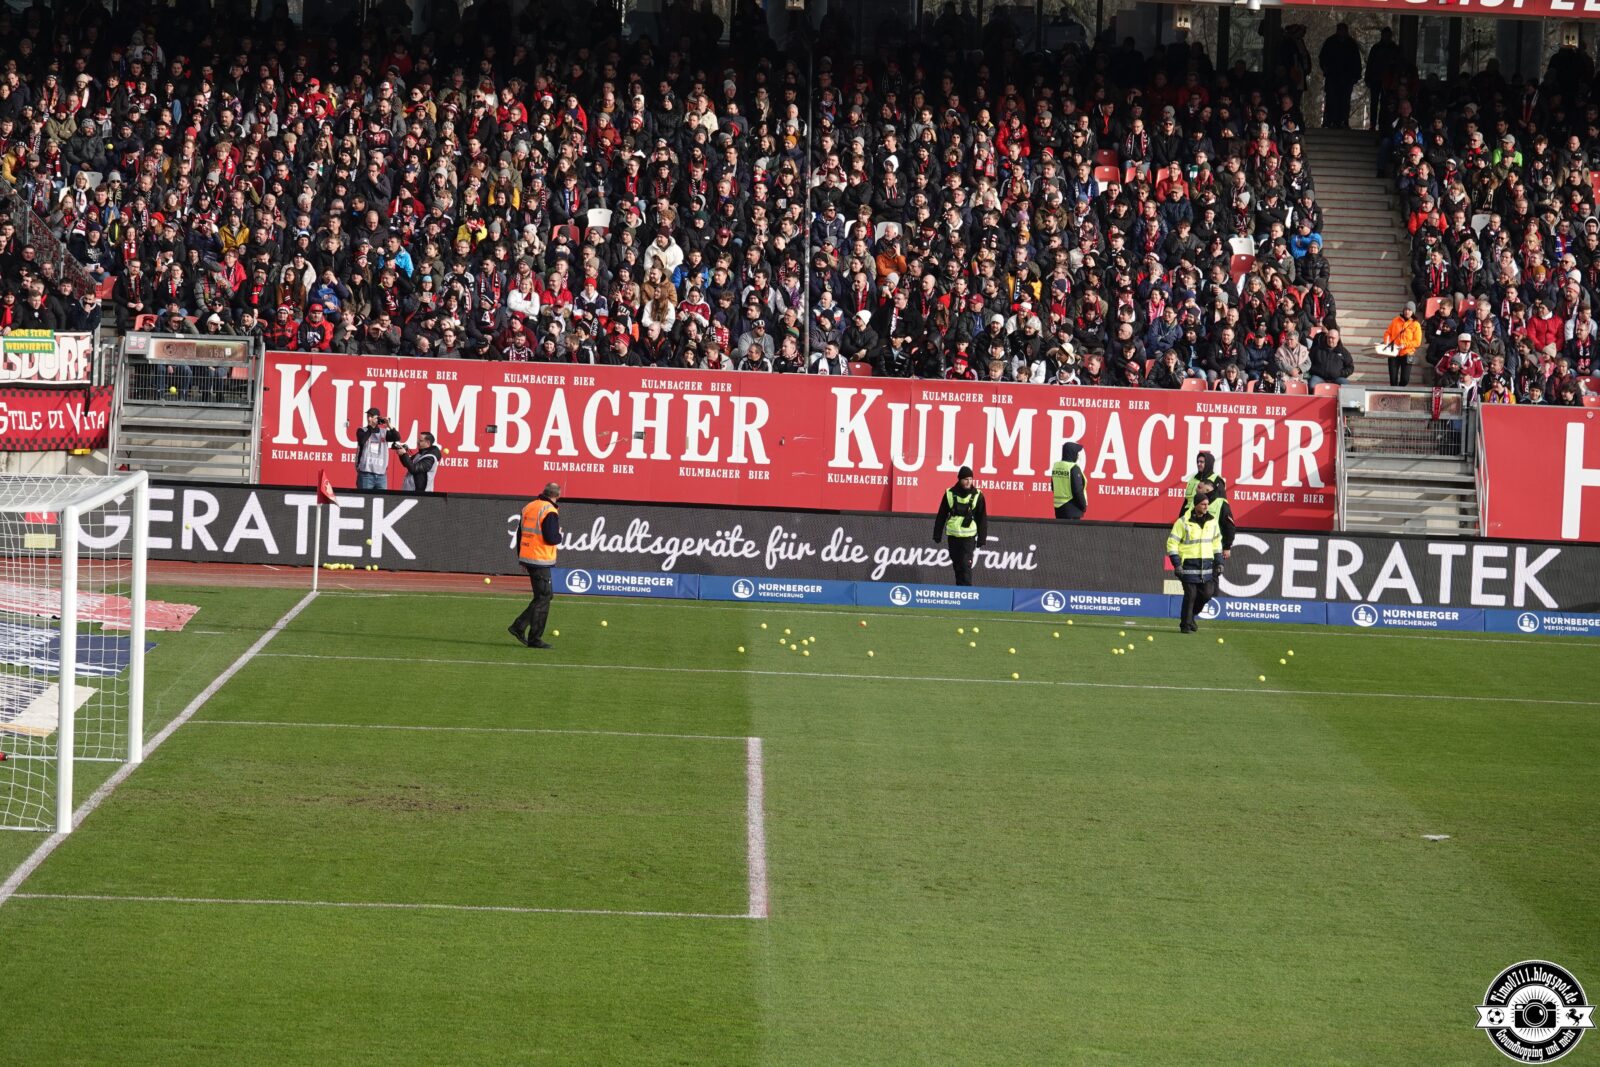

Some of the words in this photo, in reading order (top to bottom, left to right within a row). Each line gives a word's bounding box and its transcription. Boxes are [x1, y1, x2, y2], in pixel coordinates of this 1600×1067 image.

[366, 367, 428, 380] KULMBACHER
[436, 370, 458, 381] BIER
[504, 373, 566, 385] KULMBACHER
[573, 375, 595, 386] BIER
[641, 378, 703, 391] KULMBACHER
[710, 382, 732, 392] BIER
[922, 390, 984, 403] KULMBACHER
[992, 393, 1013, 404] BIER
[1059, 396, 1121, 409] KULMBACHER
[1128, 400, 1150, 410] BIER
[272, 363, 771, 465] KULMBACHER
[1196, 402, 1258, 415] KULMBACHER
[1265, 406, 1287, 416] BIER
[827, 387, 1325, 488] KULMBACHER
[271, 449, 334, 462] KULMBACHER
[341, 452, 357, 463] BIE
[477, 458, 499, 469] BIER
[543, 460, 605, 473] KULMBACHER
[612, 464, 634, 475] BIER
[679, 466, 740, 479] KULMBACHER
[748, 469, 770, 480] BIER
[827, 473, 889, 485] KULMBACHER
[896, 476, 918, 487] BIER
[1098, 484, 1159, 497] KULMBACHER
[1234, 490, 1295, 503] KULMBACHER
[1303, 493, 1325, 504] BIER
[77, 488, 419, 560] GERATEK
[765, 525, 815, 570] für
[821, 526, 868, 562] die
[870, 547, 953, 581] ganze
[1218, 533, 1561, 609] GERATEK
[597, 574, 674, 587] NÜRNBERGER
[597, 584, 651, 593] VERSICHERUNG
[758, 583, 822, 593] NÜRNBERGER
[758, 591, 804, 599] VERSICHERUNG
[915, 589, 979, 600] NÜRNBERGER
[1070, 594, 1141, 606] NÜRNBERGER
[1225, 601, 1301, 613] NÜRNBERGER
[1070, 604, 1121, 612] VERSICHERUNG
[1383, 609, 1459, 620] NÜRNBERGER
[1226, 611, 1280, 620] VERSICHERUNG
[1383, 619, 1437, 627] VERSICHERUNG
